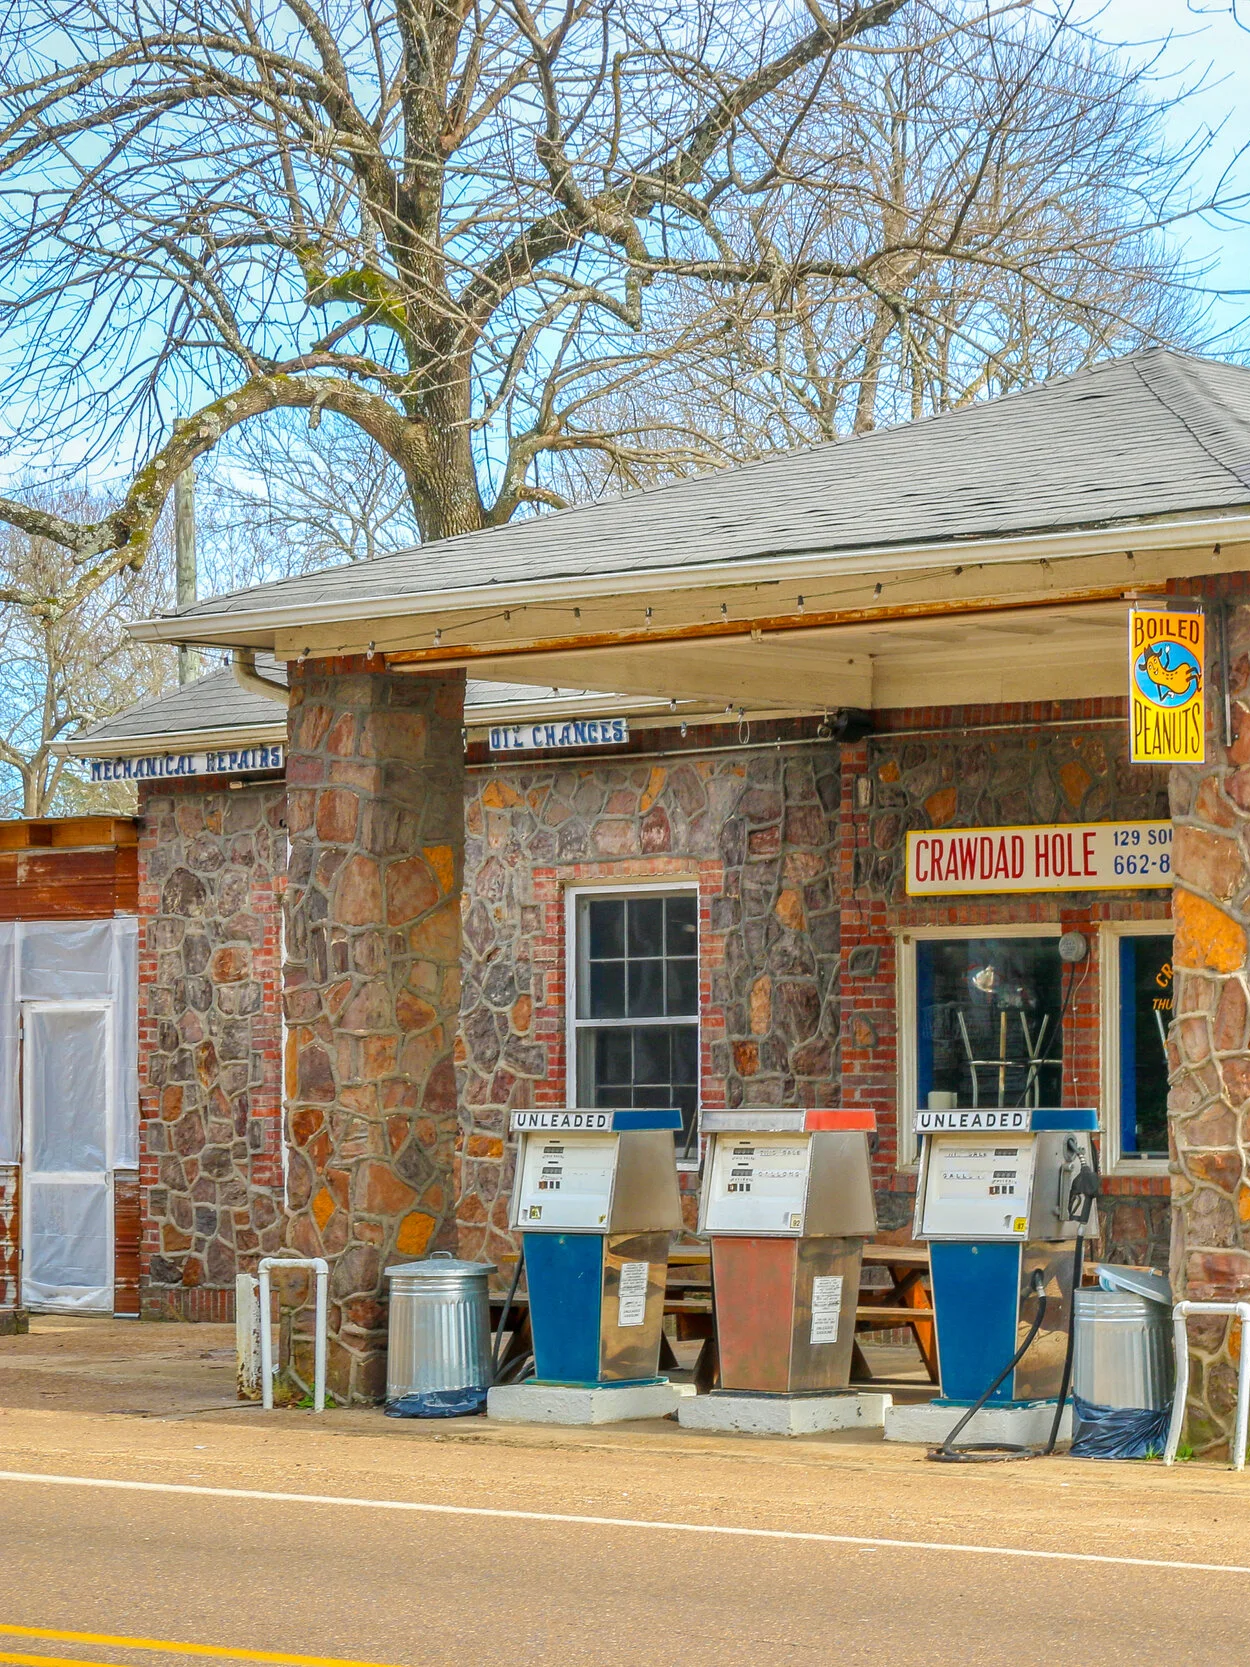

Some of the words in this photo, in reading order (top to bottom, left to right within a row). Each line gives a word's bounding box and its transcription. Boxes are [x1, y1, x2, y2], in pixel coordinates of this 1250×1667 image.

[1134, 617, 1200, 649] BOILED
[491, 726, 523, 749] OIL
[1134, 698, 1200, 755] PEANUTS
[91, 755, 196, 781] MECHANICAL
[206, 746, 281, 772] REPAIRS
[1113, 830, 1140, 846] 129
[915, 835, 1025, 882] CRAWDAD
[1035, 832, 1097, 877] HOLE
[1114, 853, 1170, 874] 662-8
[517, 1113, 606, 1128] UNLEADED
[921, 1112, 1023, 1128] UNLEADED
